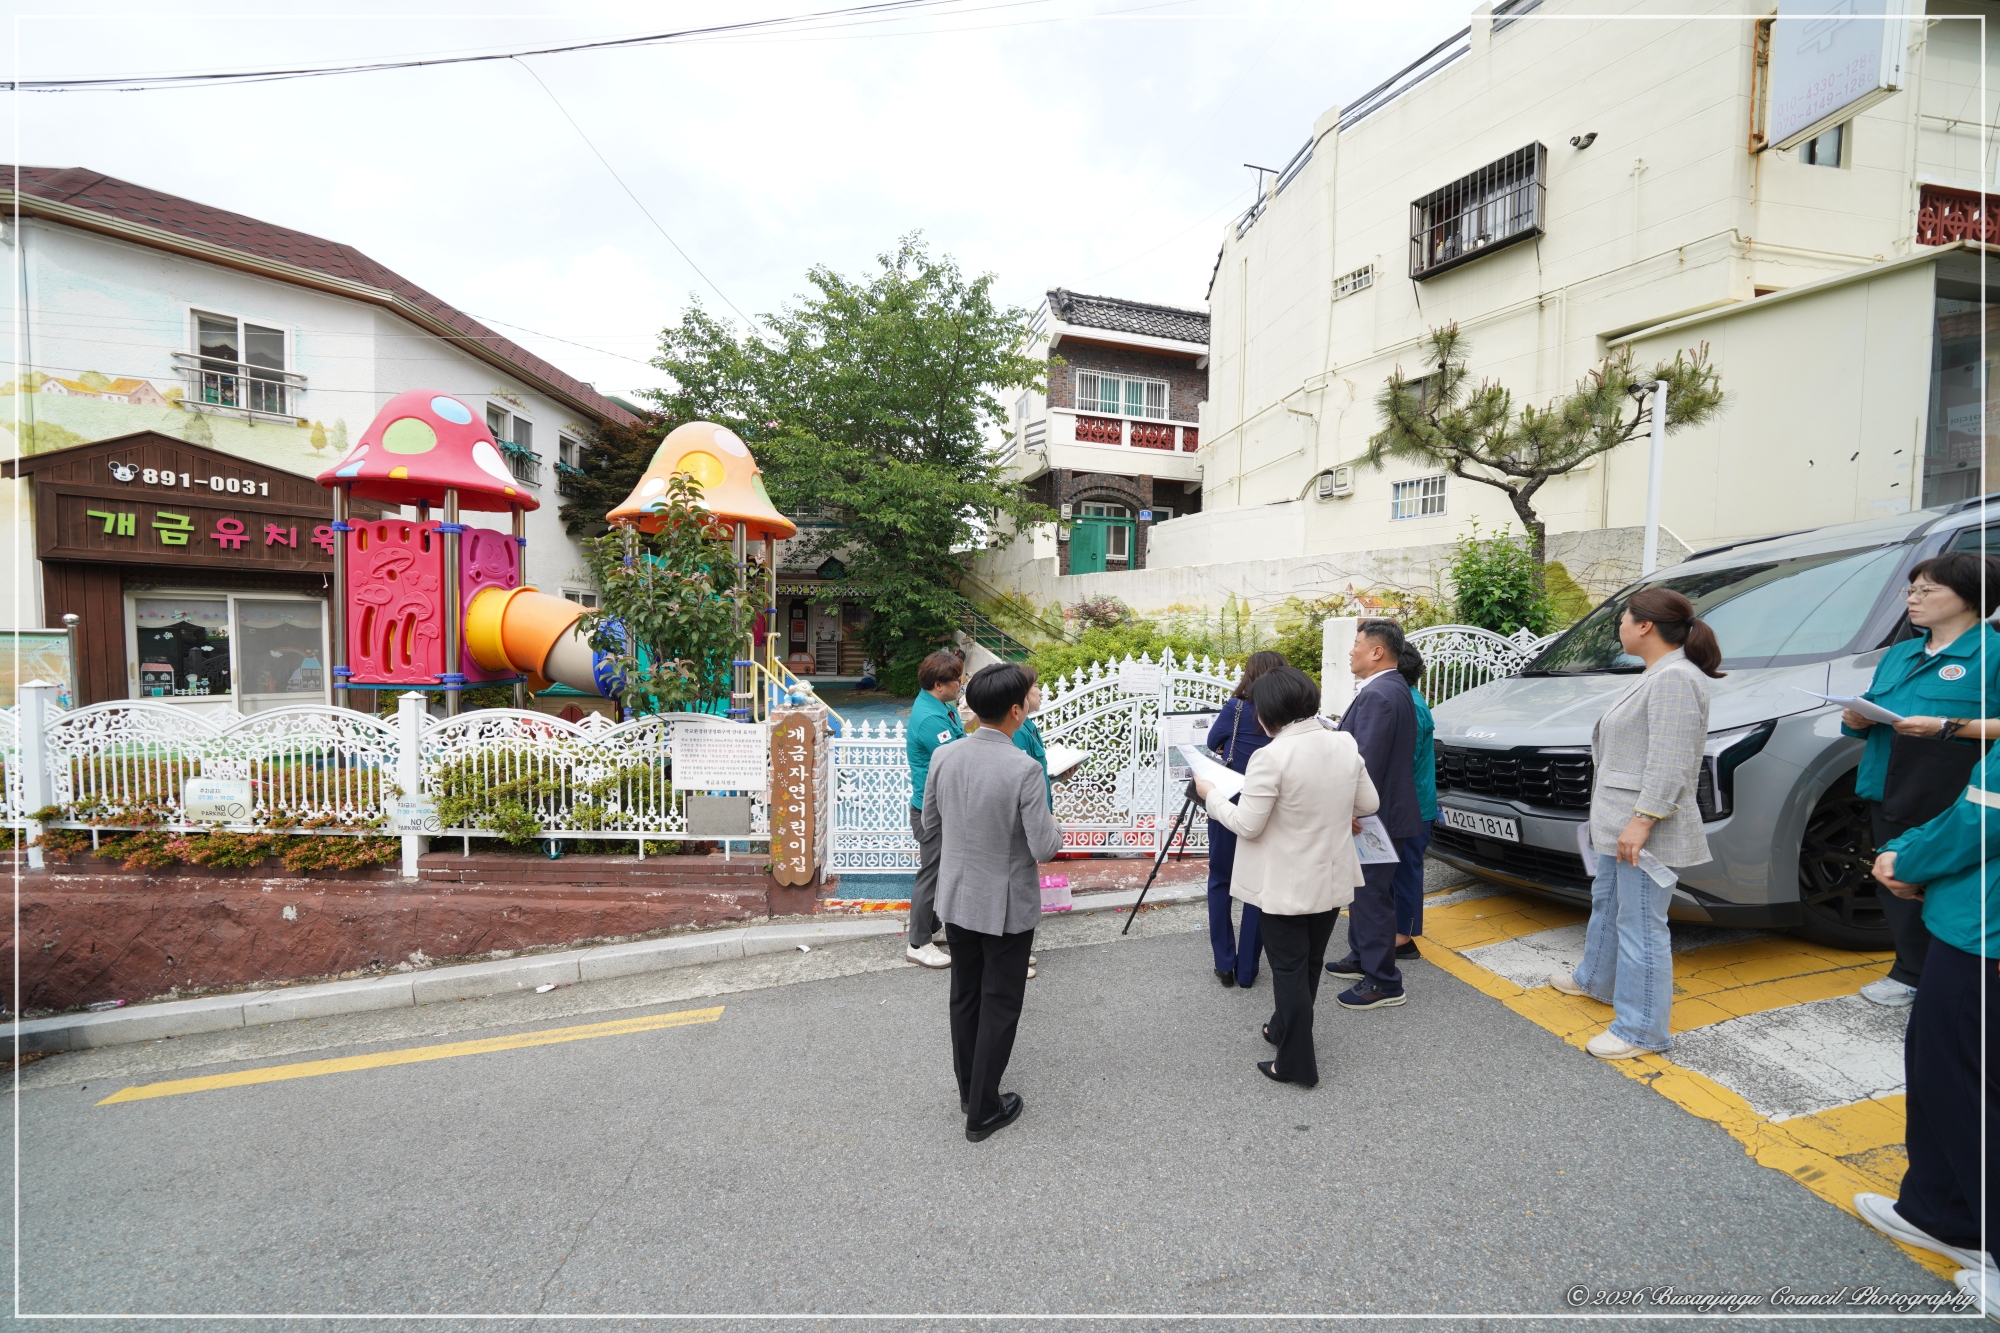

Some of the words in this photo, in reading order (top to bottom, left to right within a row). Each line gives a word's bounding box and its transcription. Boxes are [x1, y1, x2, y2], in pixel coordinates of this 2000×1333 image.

[1777, 49, 1877, 118] 010-4330-1286
[1775, 67, 1875, 135] 070-4149-1286
[142, 468, 269, 496] 891-0031
[214, 804, 226, 812] NO
[787, 725, 810, 873] 개금자연어린이집
[410, 818, 422, 826] NO
[1478, 816, 1514, 839] 1814
